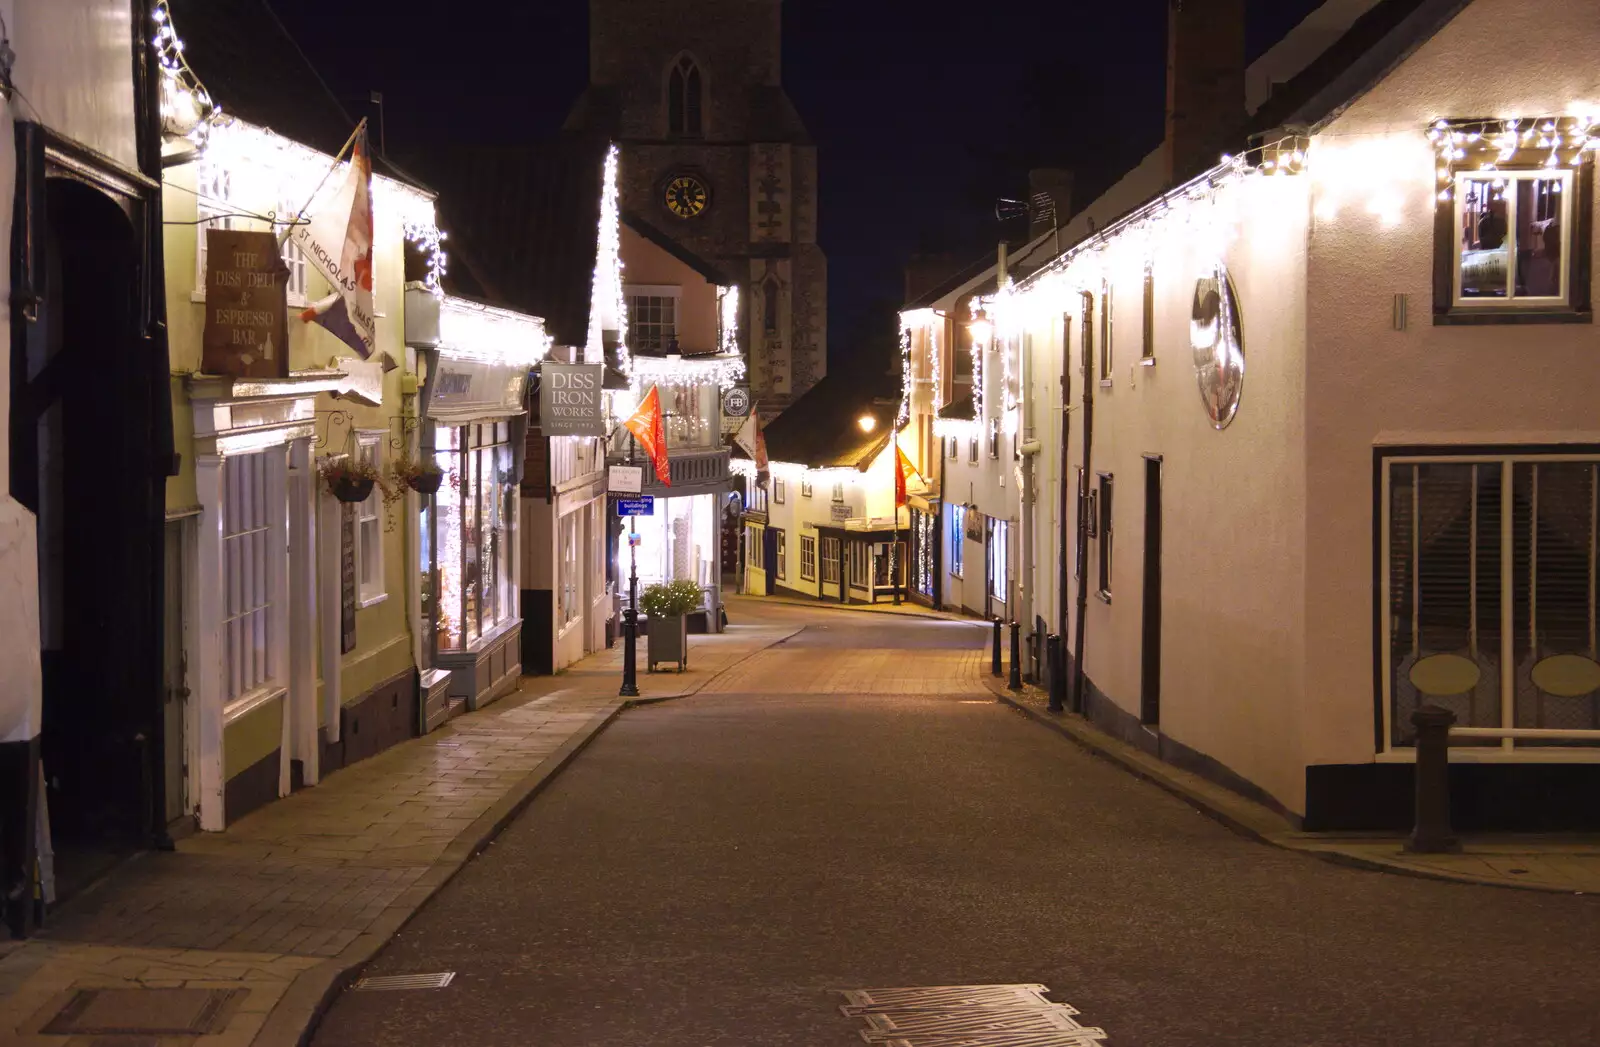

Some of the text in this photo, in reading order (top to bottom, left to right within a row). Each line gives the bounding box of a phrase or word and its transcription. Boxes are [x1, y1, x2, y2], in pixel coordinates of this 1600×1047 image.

[233, 252, 258, 268] THE
[299, 228, 357, 292] ST NICHOLAS
[215, 270, 275, 288] DISS DELI
[241, 291, 251, 306] &
[216, 309, 274, 326] ESPRESSO
[232, 328, 257, 345] BAR
[552, 373, 594, 389] DISS
[552, 391, 593, 405] IRON
[552, 406, 594, 417] WORKS
